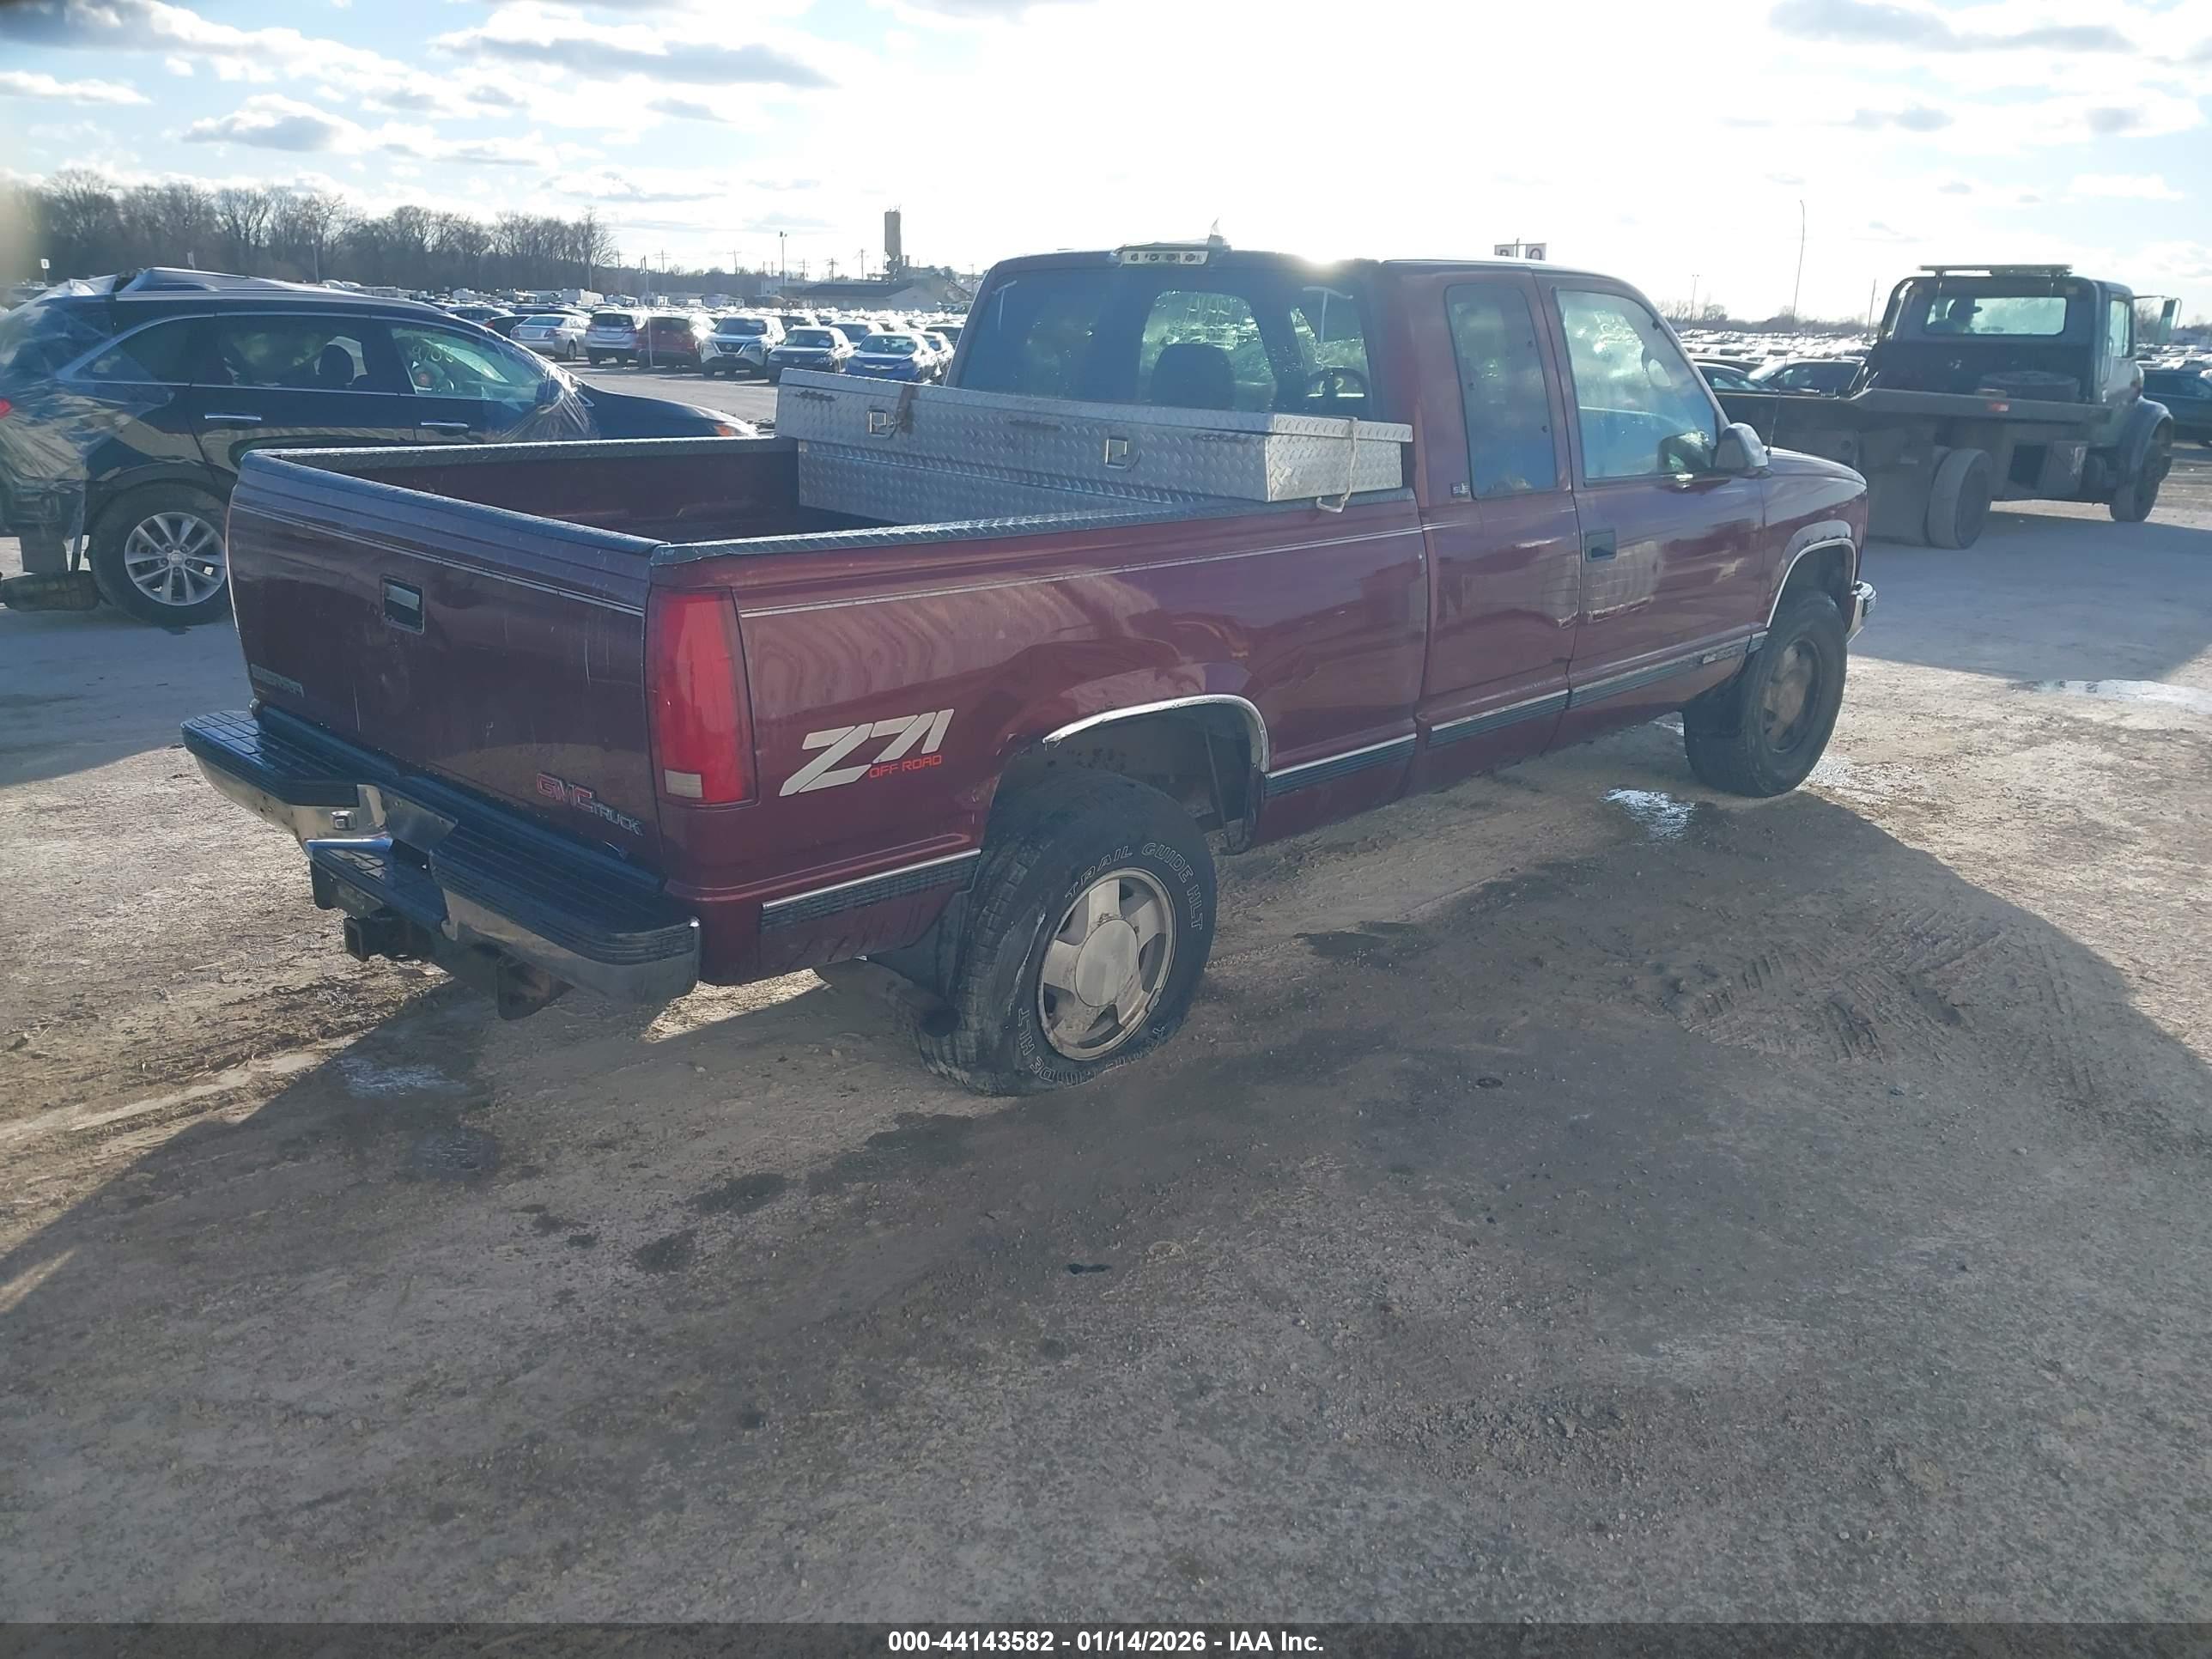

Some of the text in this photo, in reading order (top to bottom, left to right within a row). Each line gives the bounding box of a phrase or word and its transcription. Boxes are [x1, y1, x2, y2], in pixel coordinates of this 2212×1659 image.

[779, 708, 955, 797] Z71
[869, 755, 942, 779] OFF ROAD
[536, 772, 592, 812] GMC
[1064, 842, 1203, 931] TRAIL GUIDE HLT
[1018, 1007, 1036, 1056] HLT
